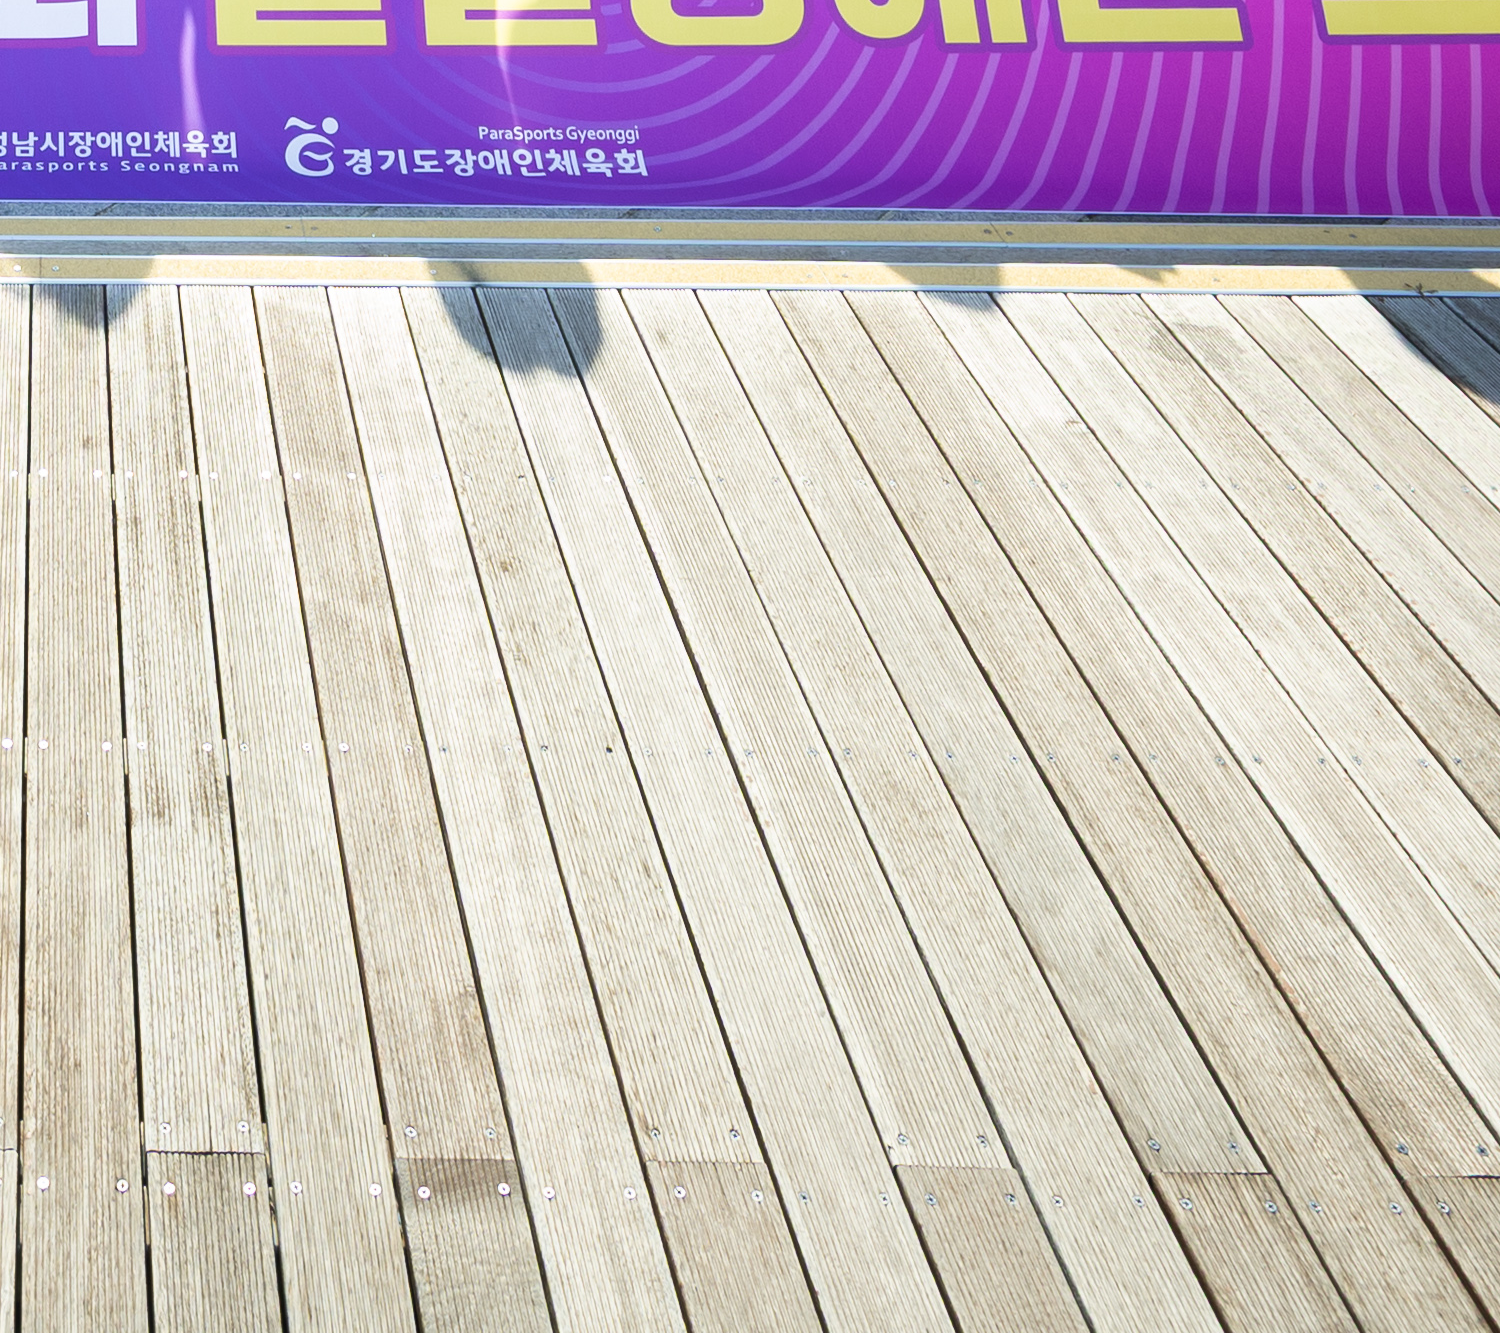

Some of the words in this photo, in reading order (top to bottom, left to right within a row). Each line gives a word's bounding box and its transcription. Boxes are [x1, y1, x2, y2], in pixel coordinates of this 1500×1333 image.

[477, 125, 564, 144] ParaSports
[565, 125, 641, 145] Gyeonggi
[120, 159, 240, 175] Seongnam
[342, 147, 650, 178] 경기도장애인체육회
